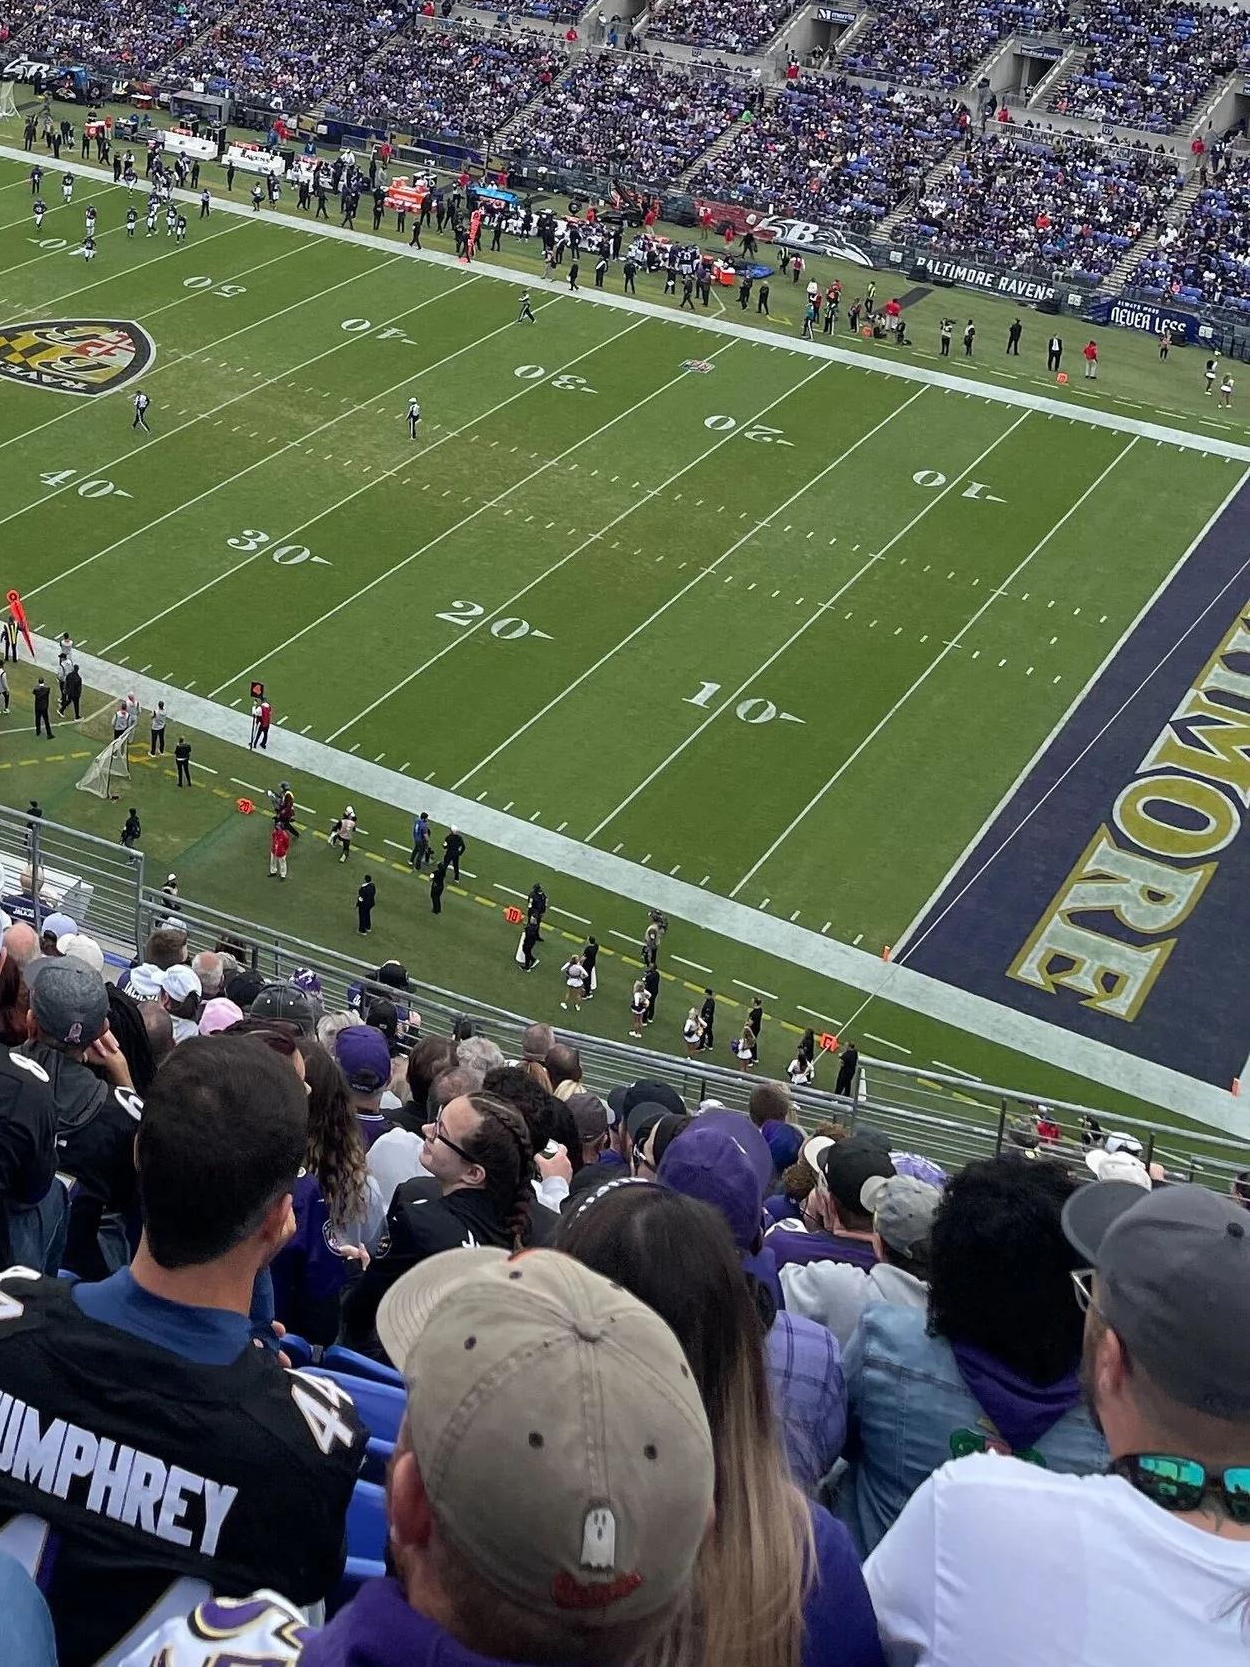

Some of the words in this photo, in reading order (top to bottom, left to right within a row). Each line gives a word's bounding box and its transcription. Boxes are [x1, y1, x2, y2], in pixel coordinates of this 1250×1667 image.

[183, 276, 247, 298] 50
[916, 257, 995, 287] BALTIMORE
[998, 276, 1056, 300] RAVENS
[341, 318, 408, 344] 40
[1111, 307, 1150, 330] NEVER
[514, 364, 588, 391] 30
[704, 414, 785, 444] 20
[40, 468, 115, 498] 40
[912, 470, 992, 500] 10
[227, 529, 311, 565] 30
[436, 600, 529, 640] 20
[682, 680, 777, 723] 10
[239, 799, 250, 813] 20
[508, 909, 519, 922] 10
